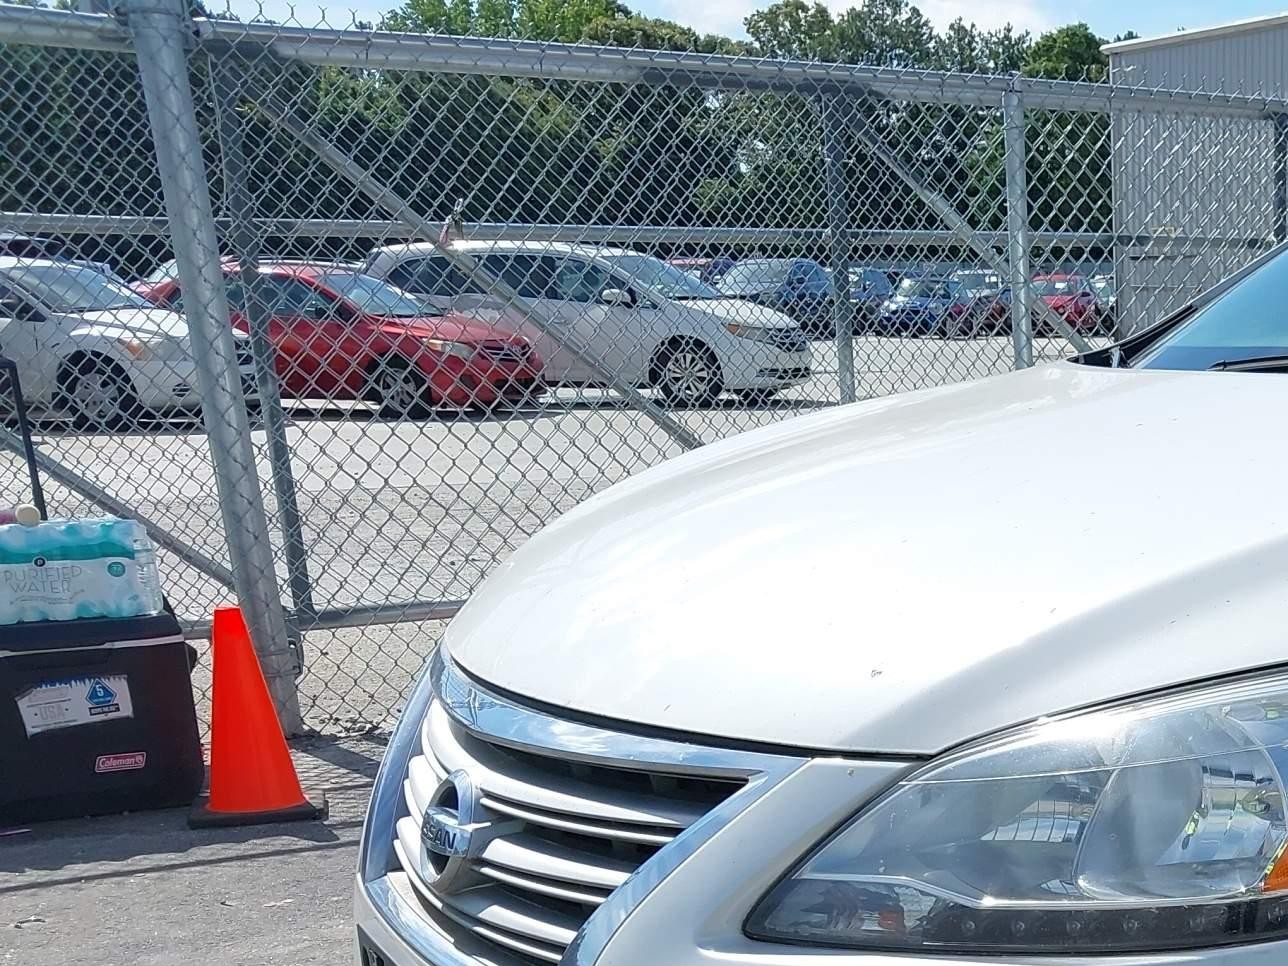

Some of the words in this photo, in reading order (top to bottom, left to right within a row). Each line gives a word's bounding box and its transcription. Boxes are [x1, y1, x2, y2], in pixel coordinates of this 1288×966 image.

[3, 565, 82, 583] PURIFIED
[9, 578, 71, 594] WATER
[99, 757, 135, 769] Coleman
